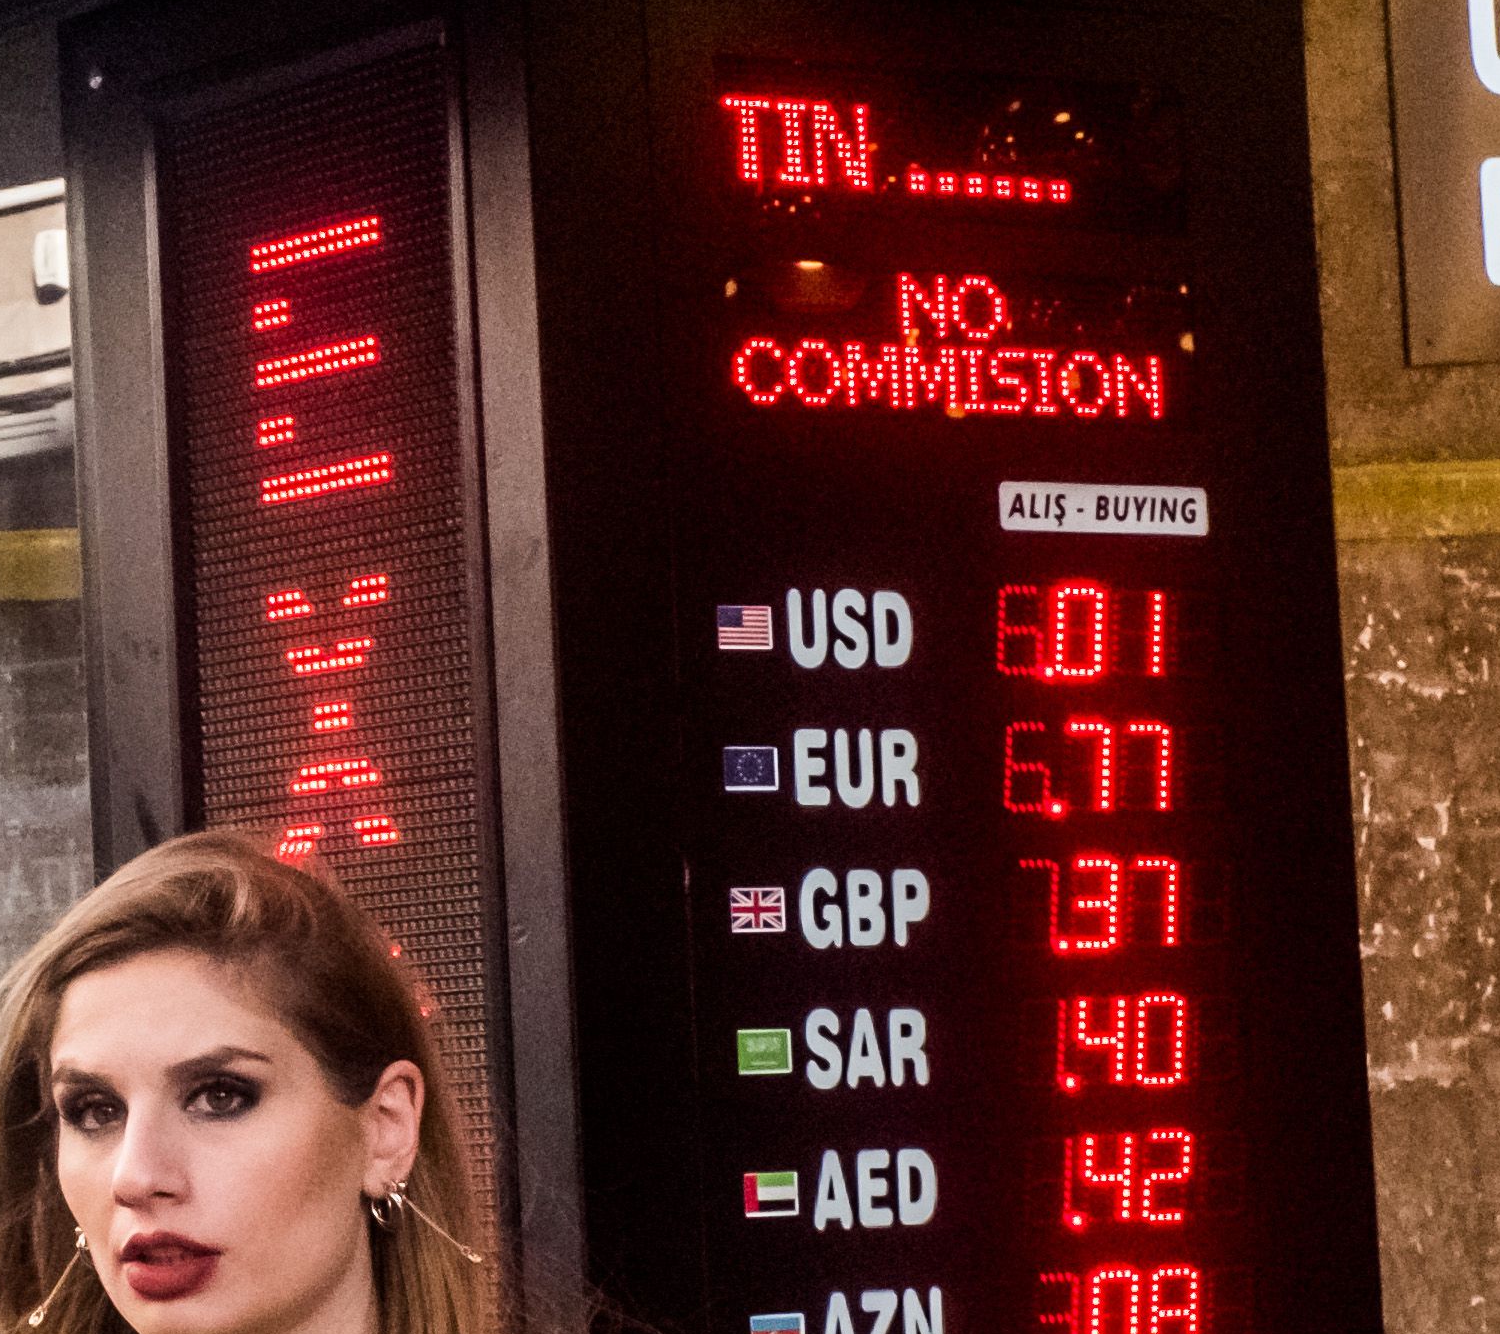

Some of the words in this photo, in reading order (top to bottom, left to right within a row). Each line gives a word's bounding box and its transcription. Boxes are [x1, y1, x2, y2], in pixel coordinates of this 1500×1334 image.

[897, 271, 1008, 340] NO
[731, 338, 1166, 419] COMMISION
[1008, 493, 1066, 528] ALIŞ
[1095, 495, 1198, 526] BUYING
[786, 588, 913, 670] USD
[793, 728, 920, 809] EUR
[799, 867, 930, 950] GBP
[805, 1008, 930, 1090] SAR
[814, 1148, 938, 1231] AED
